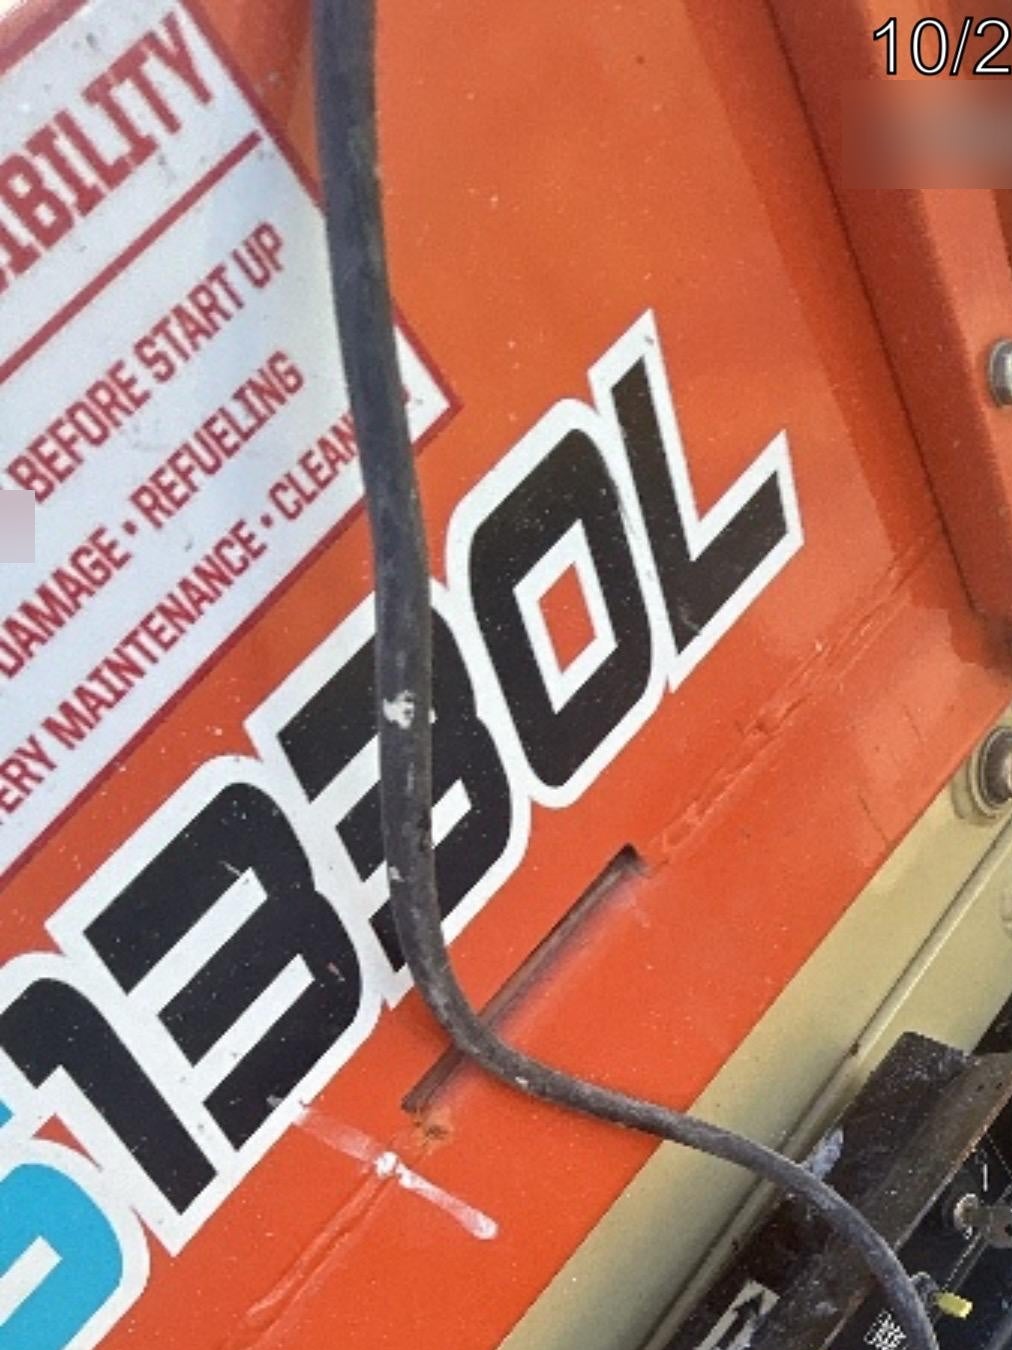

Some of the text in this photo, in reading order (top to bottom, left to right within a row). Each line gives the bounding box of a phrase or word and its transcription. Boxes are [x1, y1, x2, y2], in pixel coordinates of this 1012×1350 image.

[0, 11, 213, 293] IBILITY
[6, 222, 284, 503] BEFORE START UP
[129, 351, 304, 529] REFUELING
[0, 395, 392, 820] ERY MAINTENANCE CLEAN
